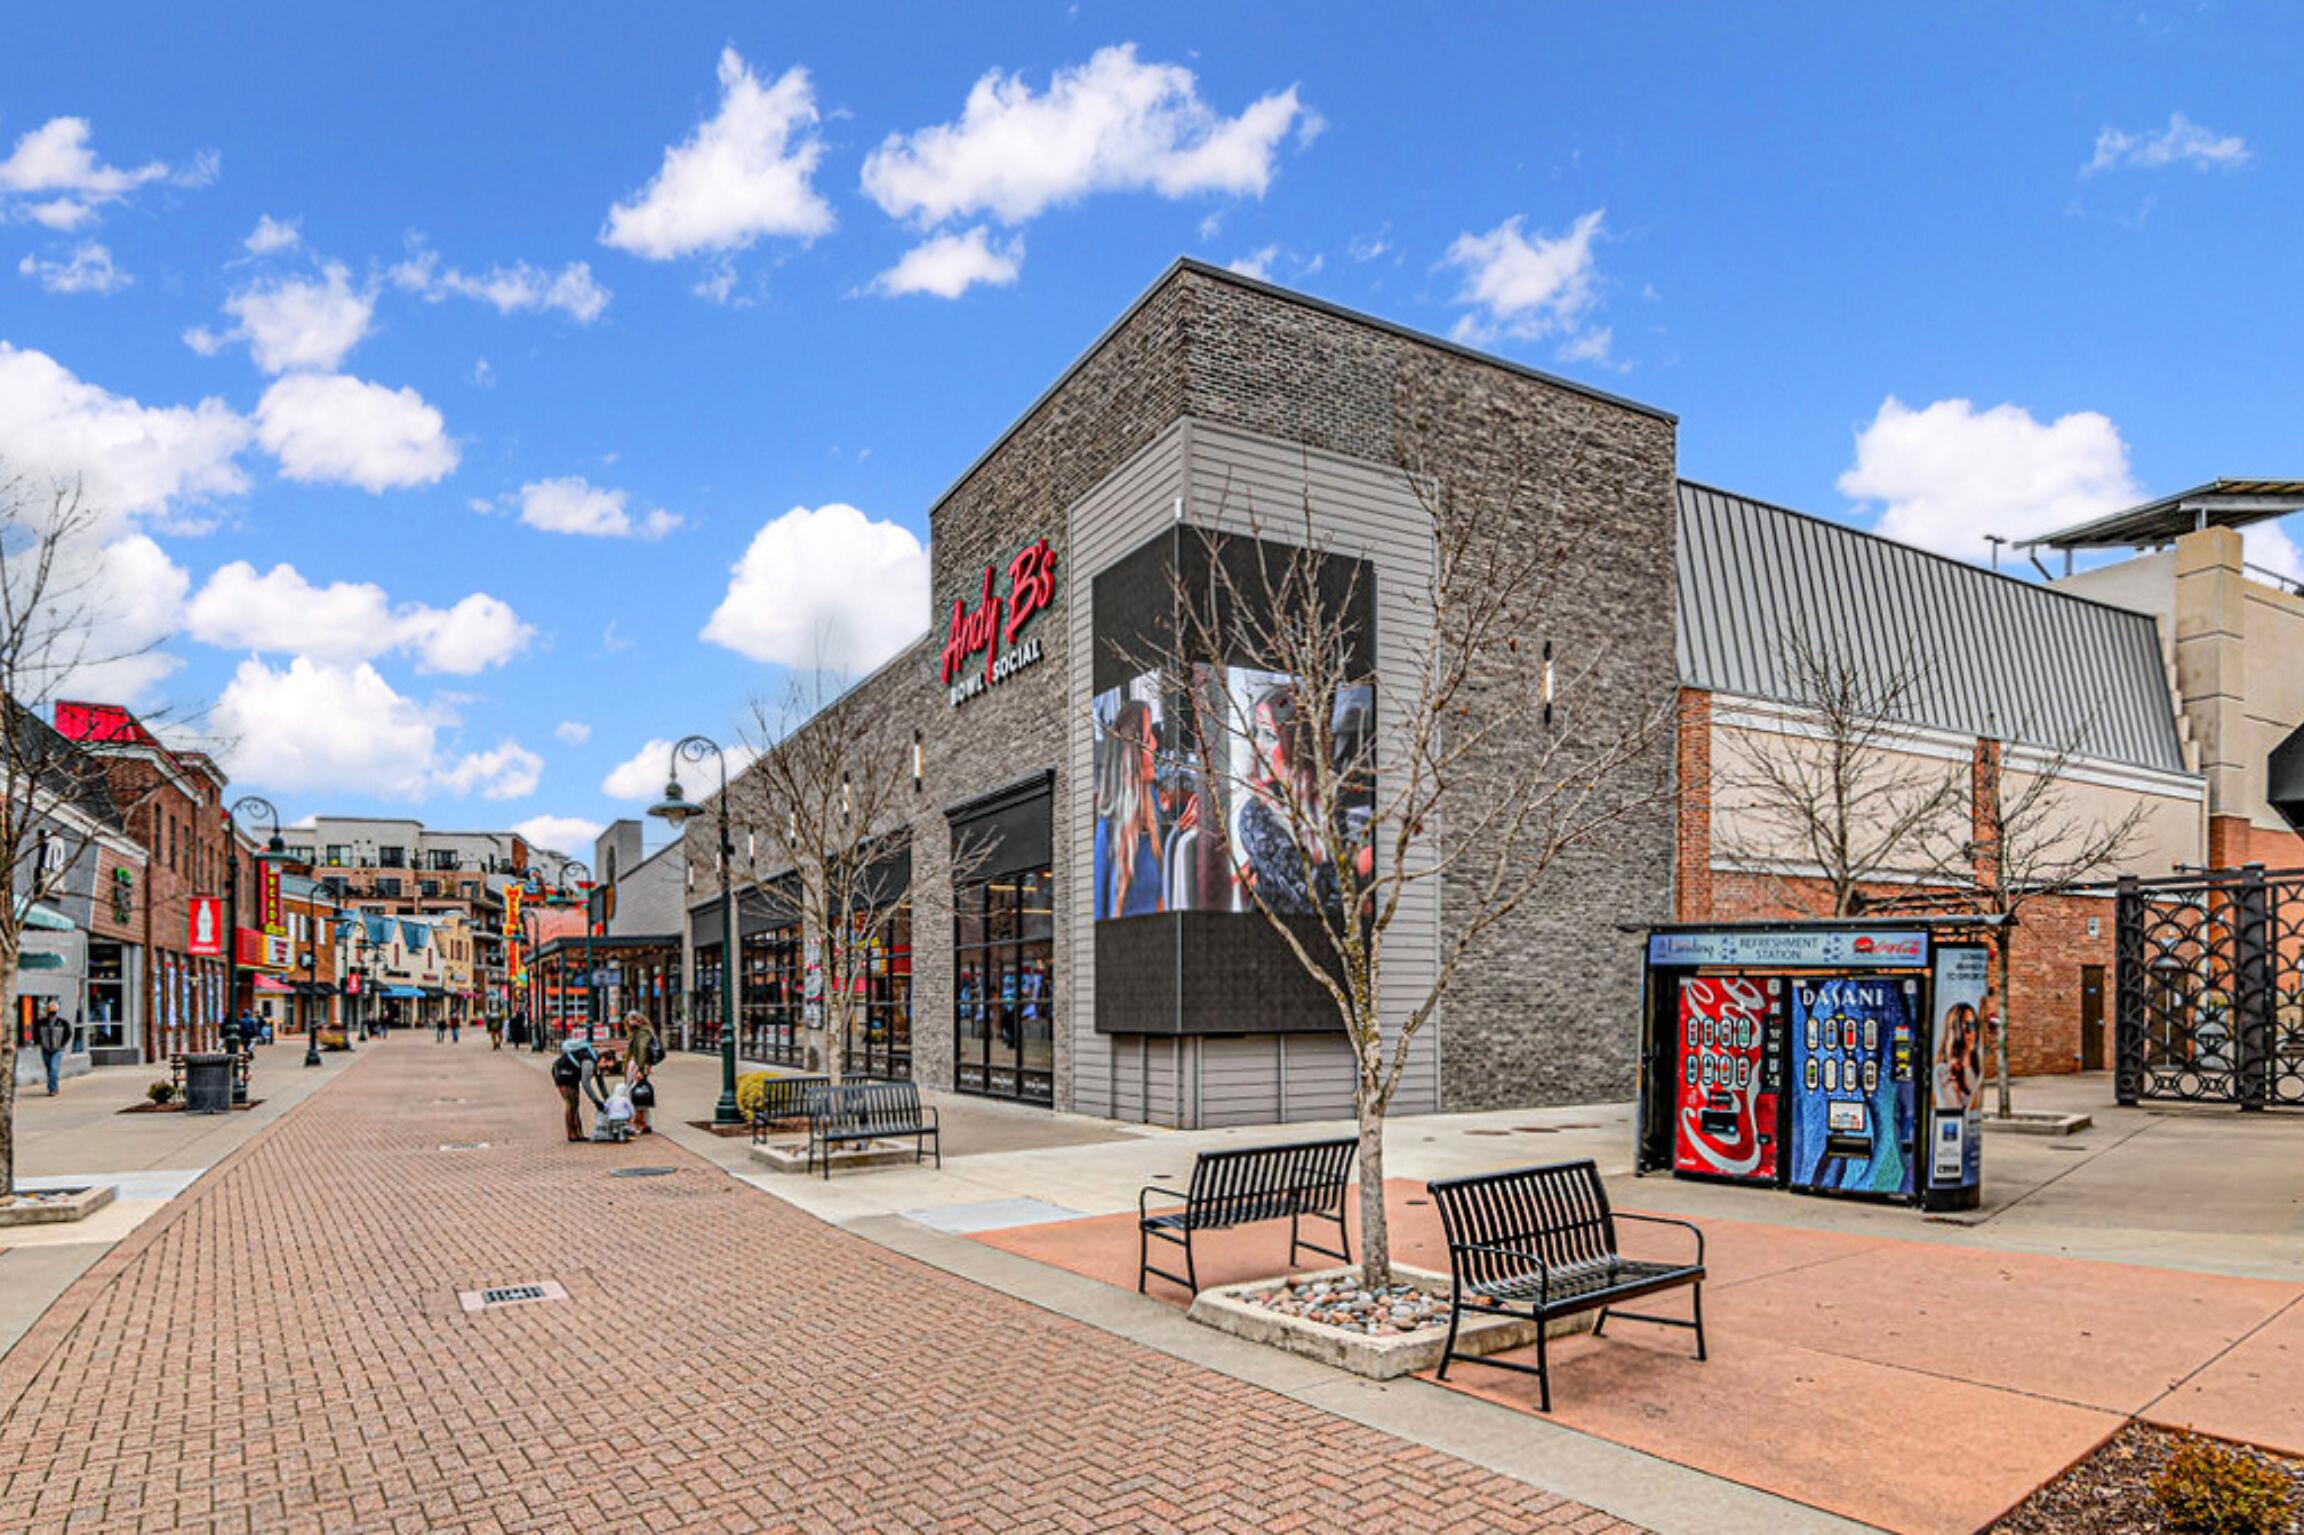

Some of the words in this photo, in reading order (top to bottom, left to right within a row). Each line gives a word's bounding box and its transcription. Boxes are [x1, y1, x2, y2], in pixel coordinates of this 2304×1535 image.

[940, 565, 1003, 684] Andy
[1004, 538, 1057, 645] B's
[950, 671, 985, 707] BOWL
[993, 638, 1043, 683] SOCIAL
[1740, 936, 1818, 948] REFRESHMENT
[1756, 949, 1801, 960] STATION
[1802, 982, 1884, 1010] DASANI
